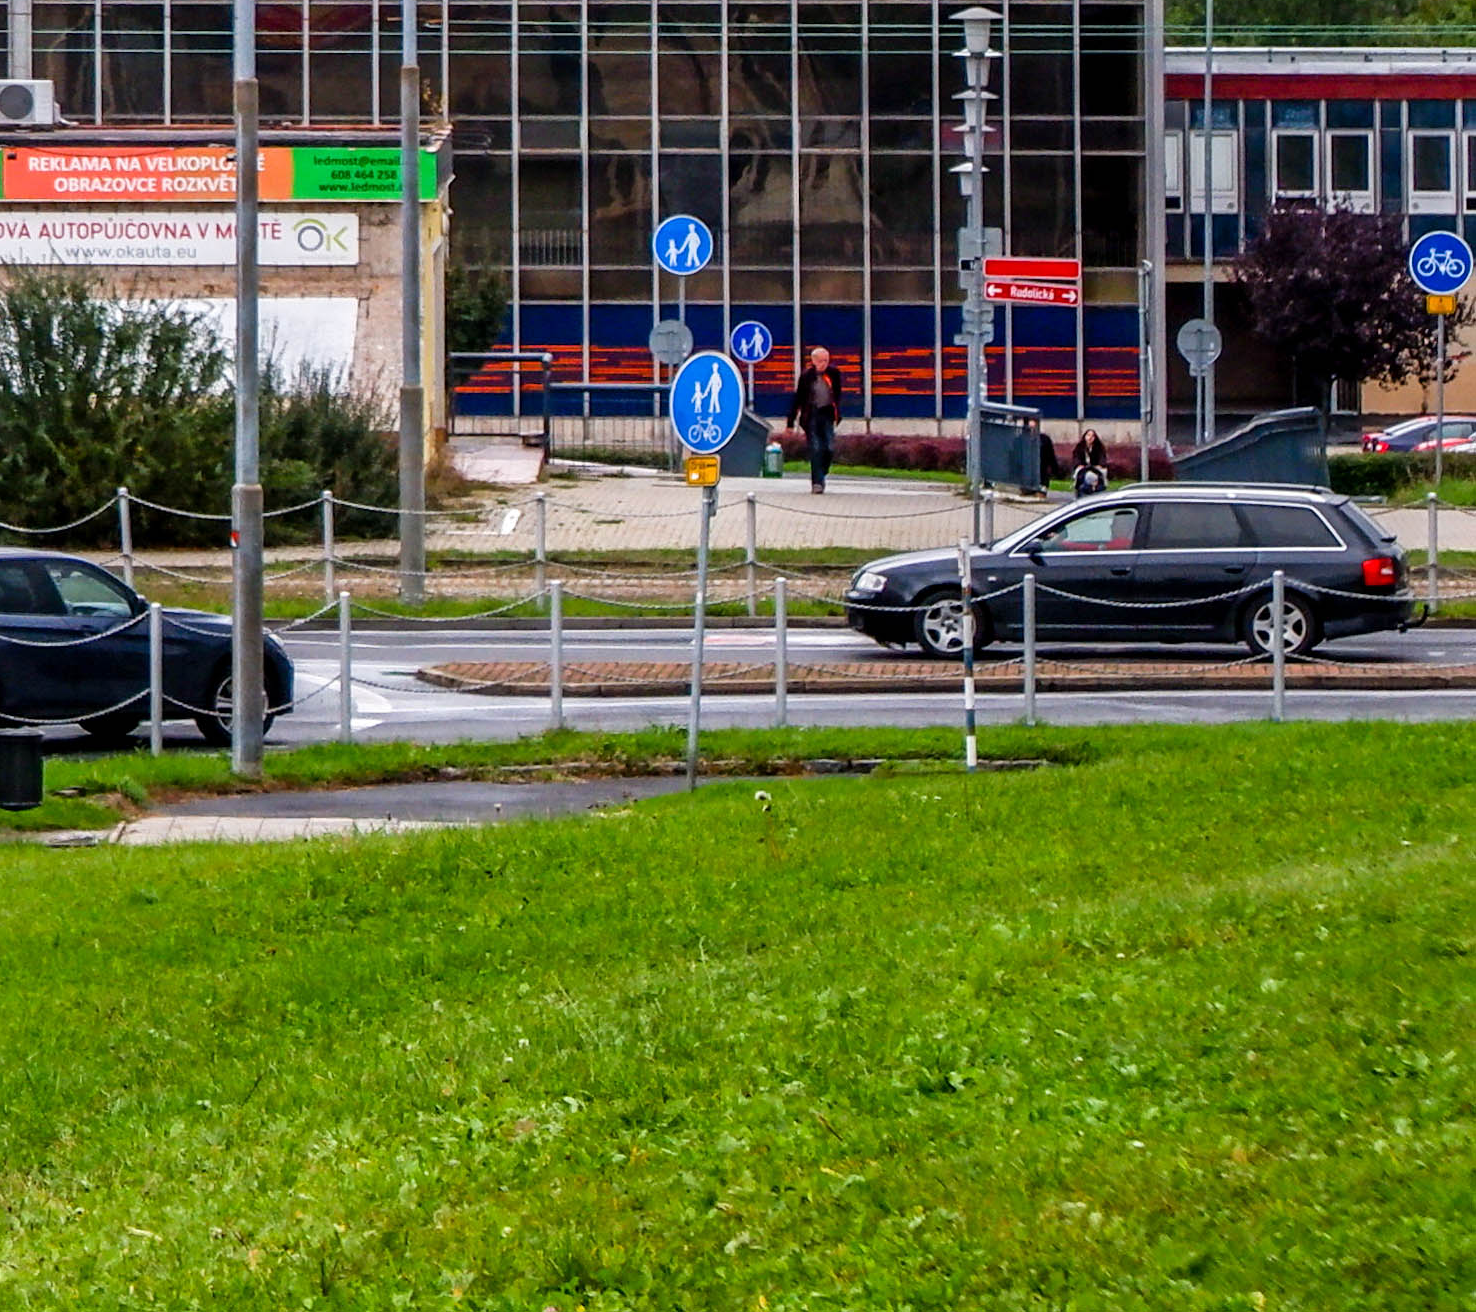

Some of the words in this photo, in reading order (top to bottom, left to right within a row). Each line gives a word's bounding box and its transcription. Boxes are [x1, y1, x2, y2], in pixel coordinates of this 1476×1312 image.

[28, 156, 109, 172] REKLAMA
[116, 156, 141, 172] NA
[144, 152, 265, 173] VELKOPLOÉ
[314, 155, 401, 168] ledmost@email
[54, 177, 157, 193] OBRAZOVCE
[319, 182, 403, 192] www.ledmost.
[38, 217, 191, 240] AUTOPŮJČOVNA
[196, 222, 210, 239] V
[215, 219, 282, 240] MTĚ
[65, 245, 197, 259] www.okauta.eu
